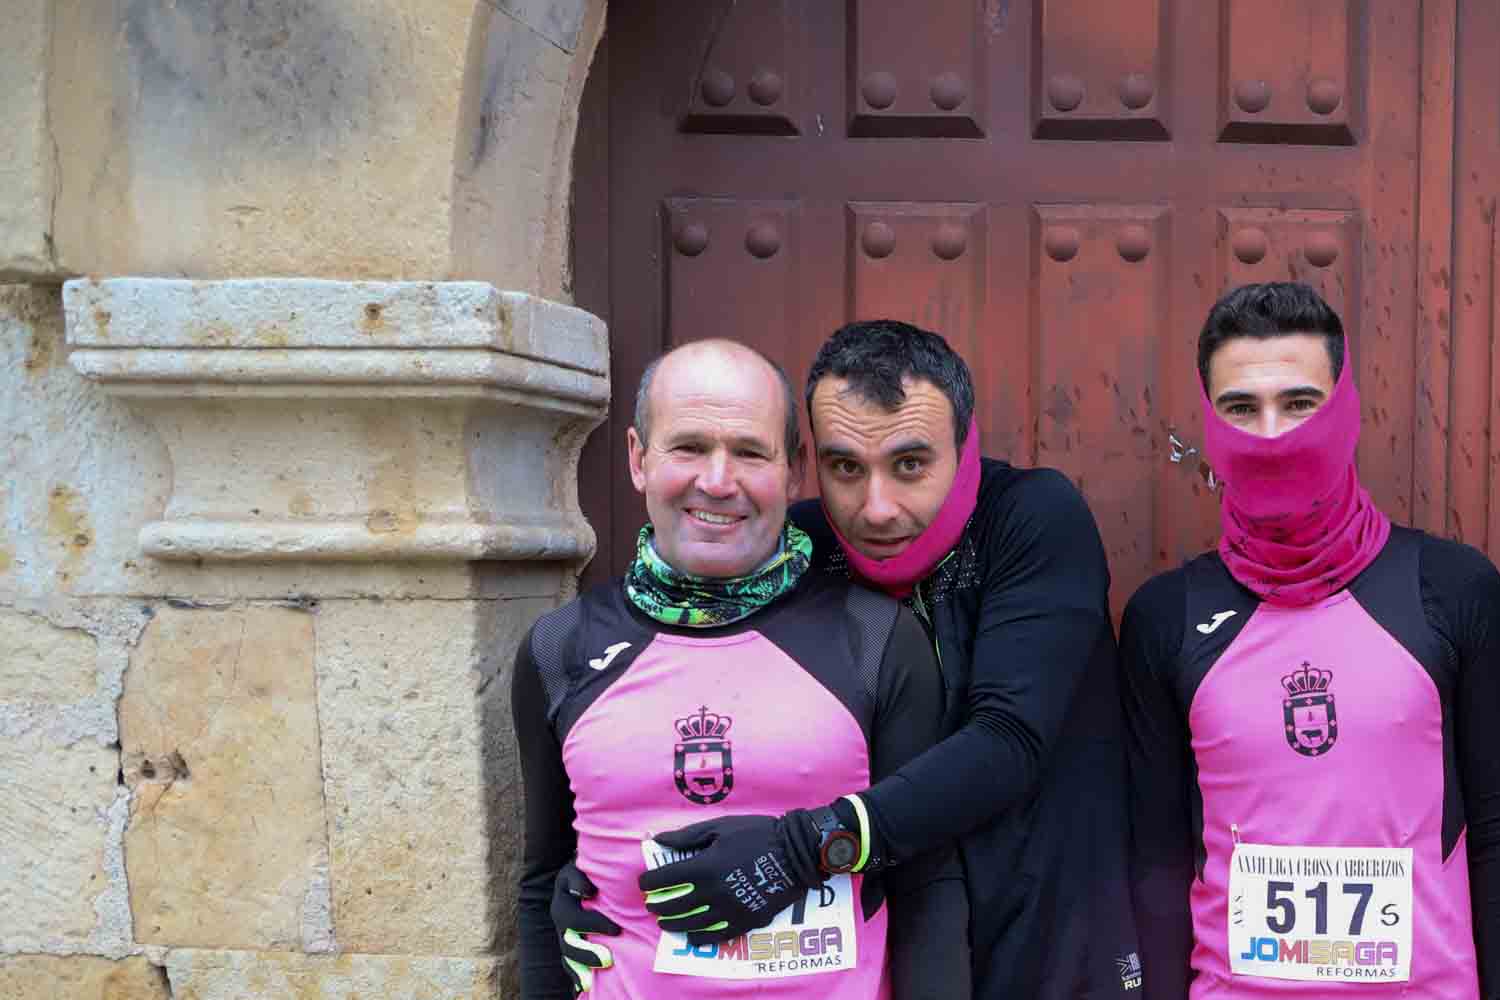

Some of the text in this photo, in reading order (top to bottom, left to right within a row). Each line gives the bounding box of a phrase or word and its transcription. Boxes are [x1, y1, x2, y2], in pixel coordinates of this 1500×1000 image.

[1265, 881, 1374, 936] 517
[1380, 903, 1400, 926] S
[757, 955, 842, 973] REFORMAS
[1316, 967, 1396, 978] REFORMAS
[1124, 976, 1142, 991] RU
